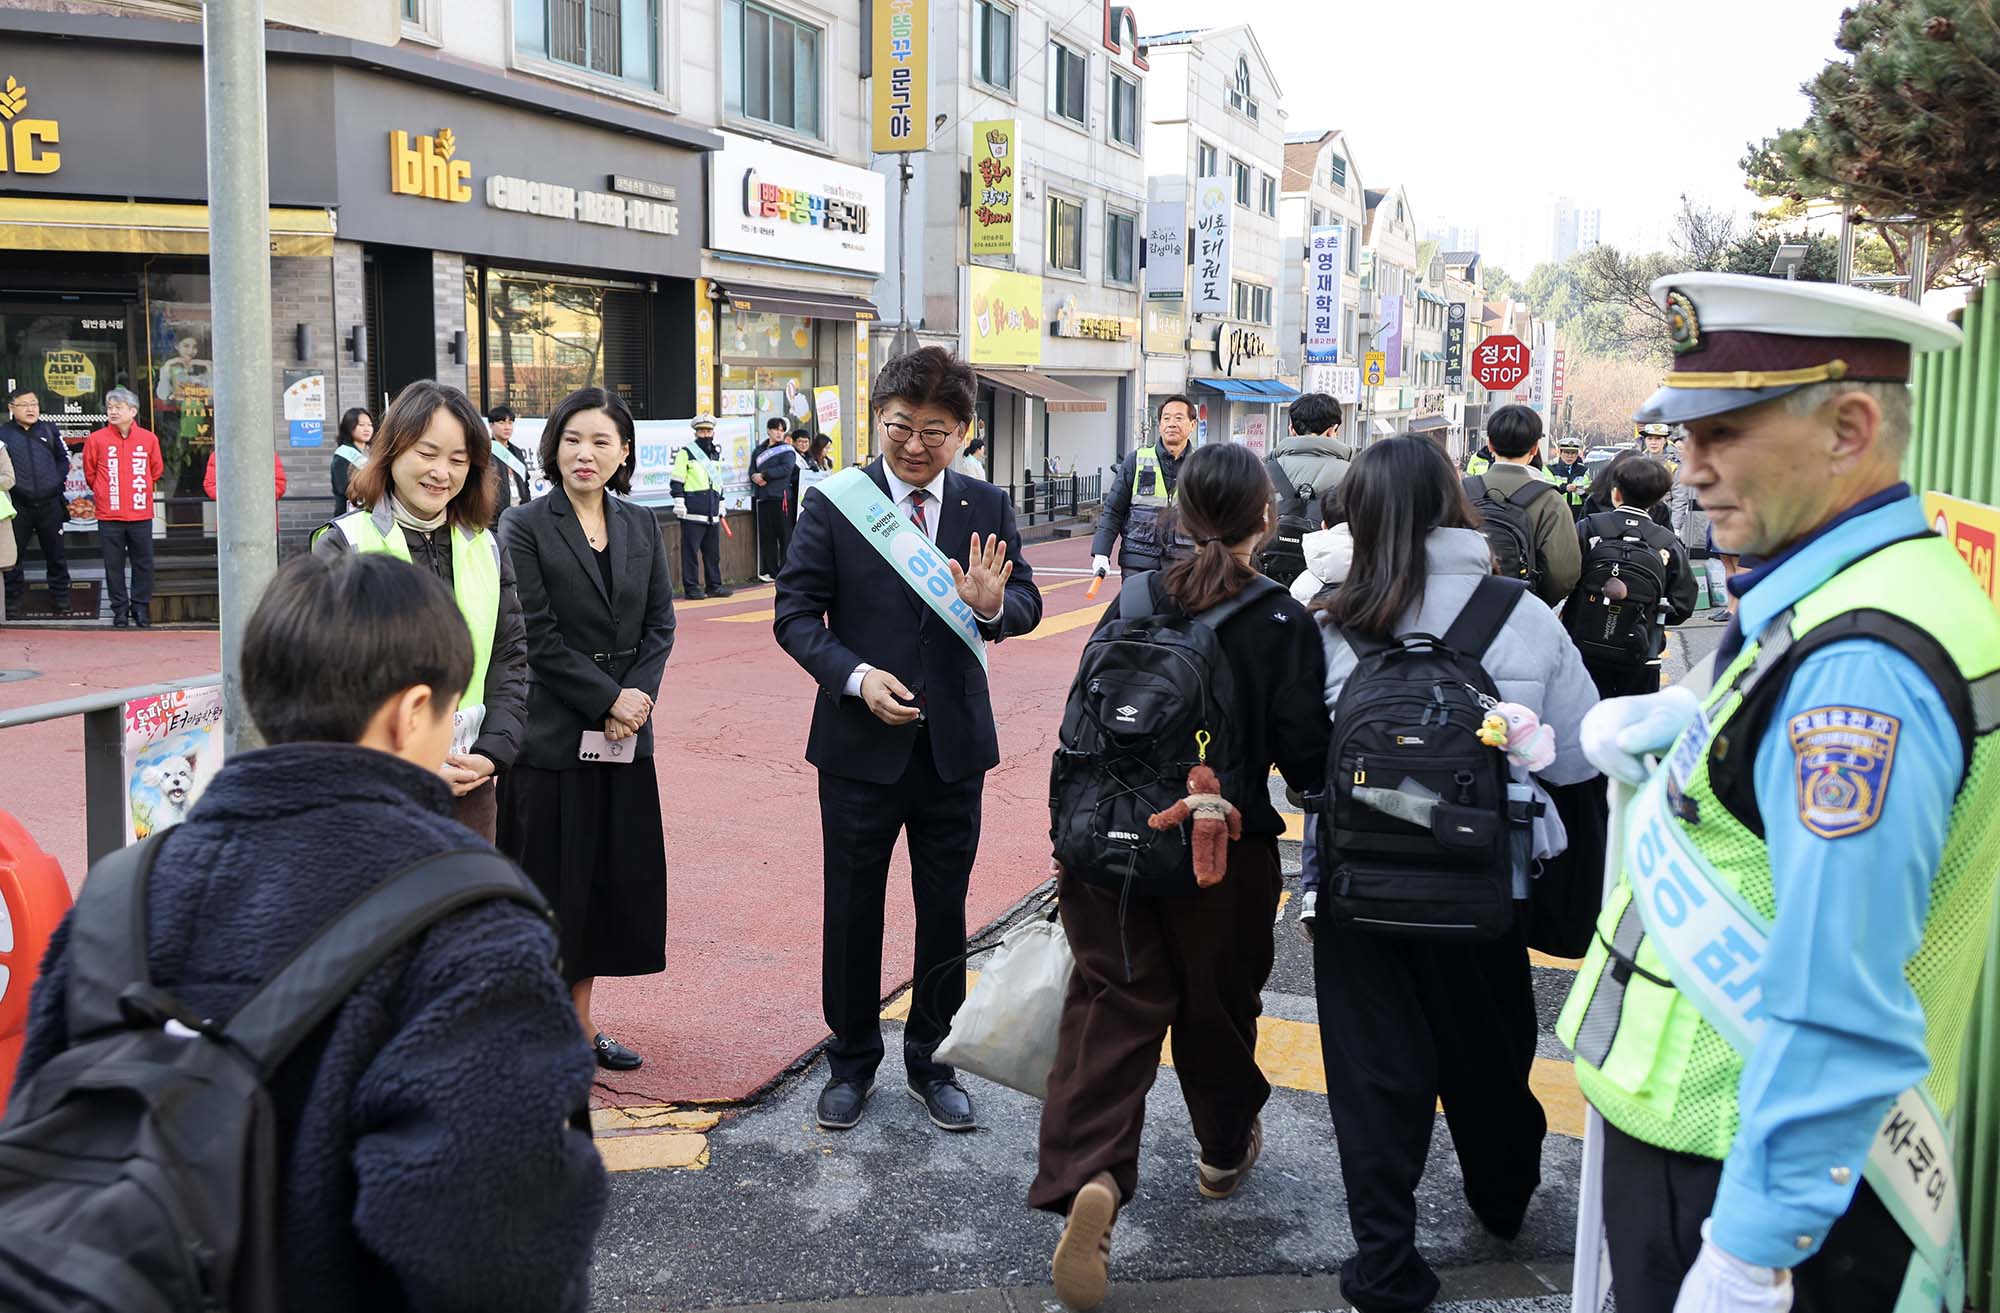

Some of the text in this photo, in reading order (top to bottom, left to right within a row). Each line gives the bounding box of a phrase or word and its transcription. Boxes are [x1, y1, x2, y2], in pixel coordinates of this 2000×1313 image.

[891, 68, 911, 137] 문구야
[390, 129, 472, 203] bhc
[1198, 214, 1227, 236] 비룡
[1149, 230, 1176, 243] 조이스
[1202, 238, 1224, 300] 태권도
[1314, 252, 1333, 334] 영재학원
[81, 319, 124, 329] 일반음식점
[48, 354, 84, 362] NEW
[1480, 343, 1522, 367] 정지
[48, 364, 85, 374] APP
[1481, 367, 1522, 383] STOP
[108, 446, 117, 456] 2
[641, 445, 666, 466] 먼저
[871, 511, 895, 533] 아이먼저
[881, 520, 900, 538] 캠페인
[136, 697, 175, 728] 도파민
